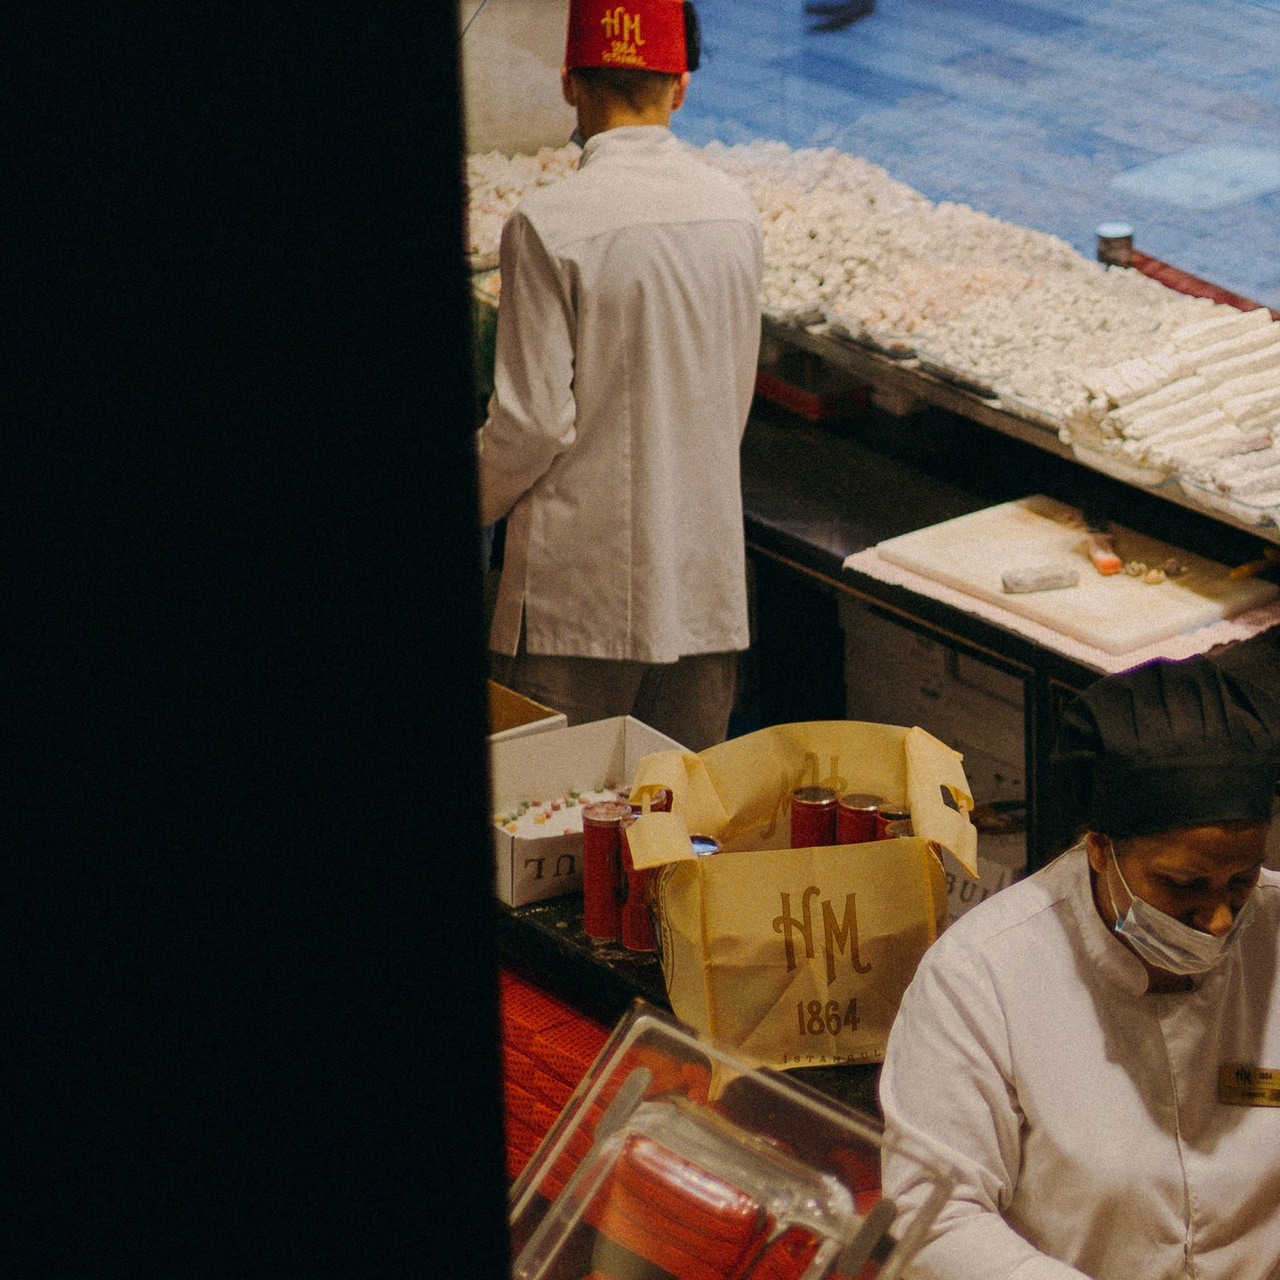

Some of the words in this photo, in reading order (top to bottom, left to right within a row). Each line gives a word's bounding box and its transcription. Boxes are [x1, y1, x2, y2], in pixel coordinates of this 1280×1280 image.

[600, 6, 646, 46] HM
[772, 886, 873, 987] HM
[796, 997, 861, 1036] 1864
